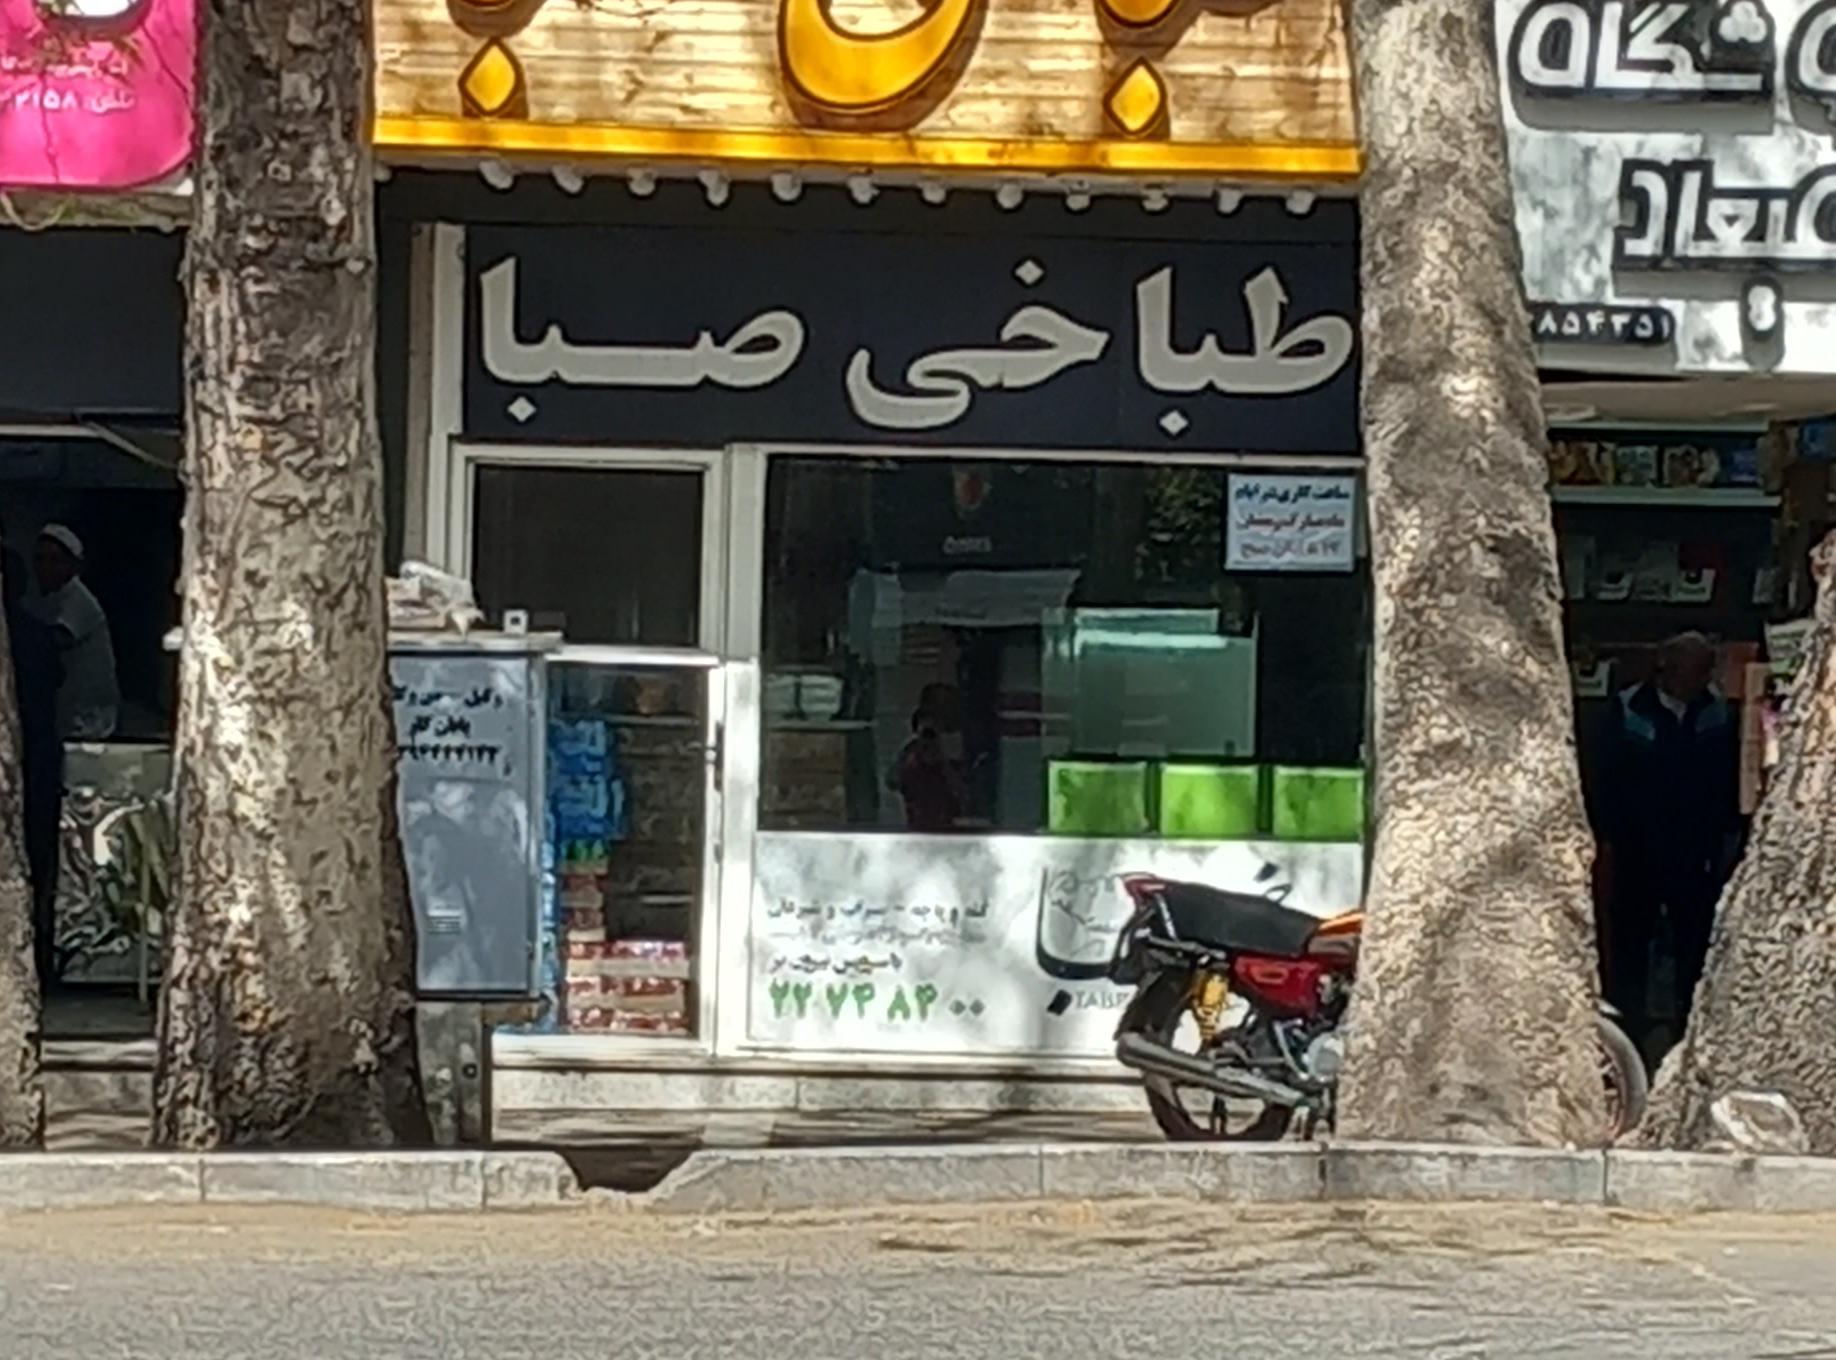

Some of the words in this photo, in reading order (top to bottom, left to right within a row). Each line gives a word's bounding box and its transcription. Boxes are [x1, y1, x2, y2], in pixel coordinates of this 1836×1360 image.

[478, 256, 806, 424] صبا
[845, 259, 1355, 436] طباخی
[1536, 310, 1670, 339] ۸۵۴۳۵۱
